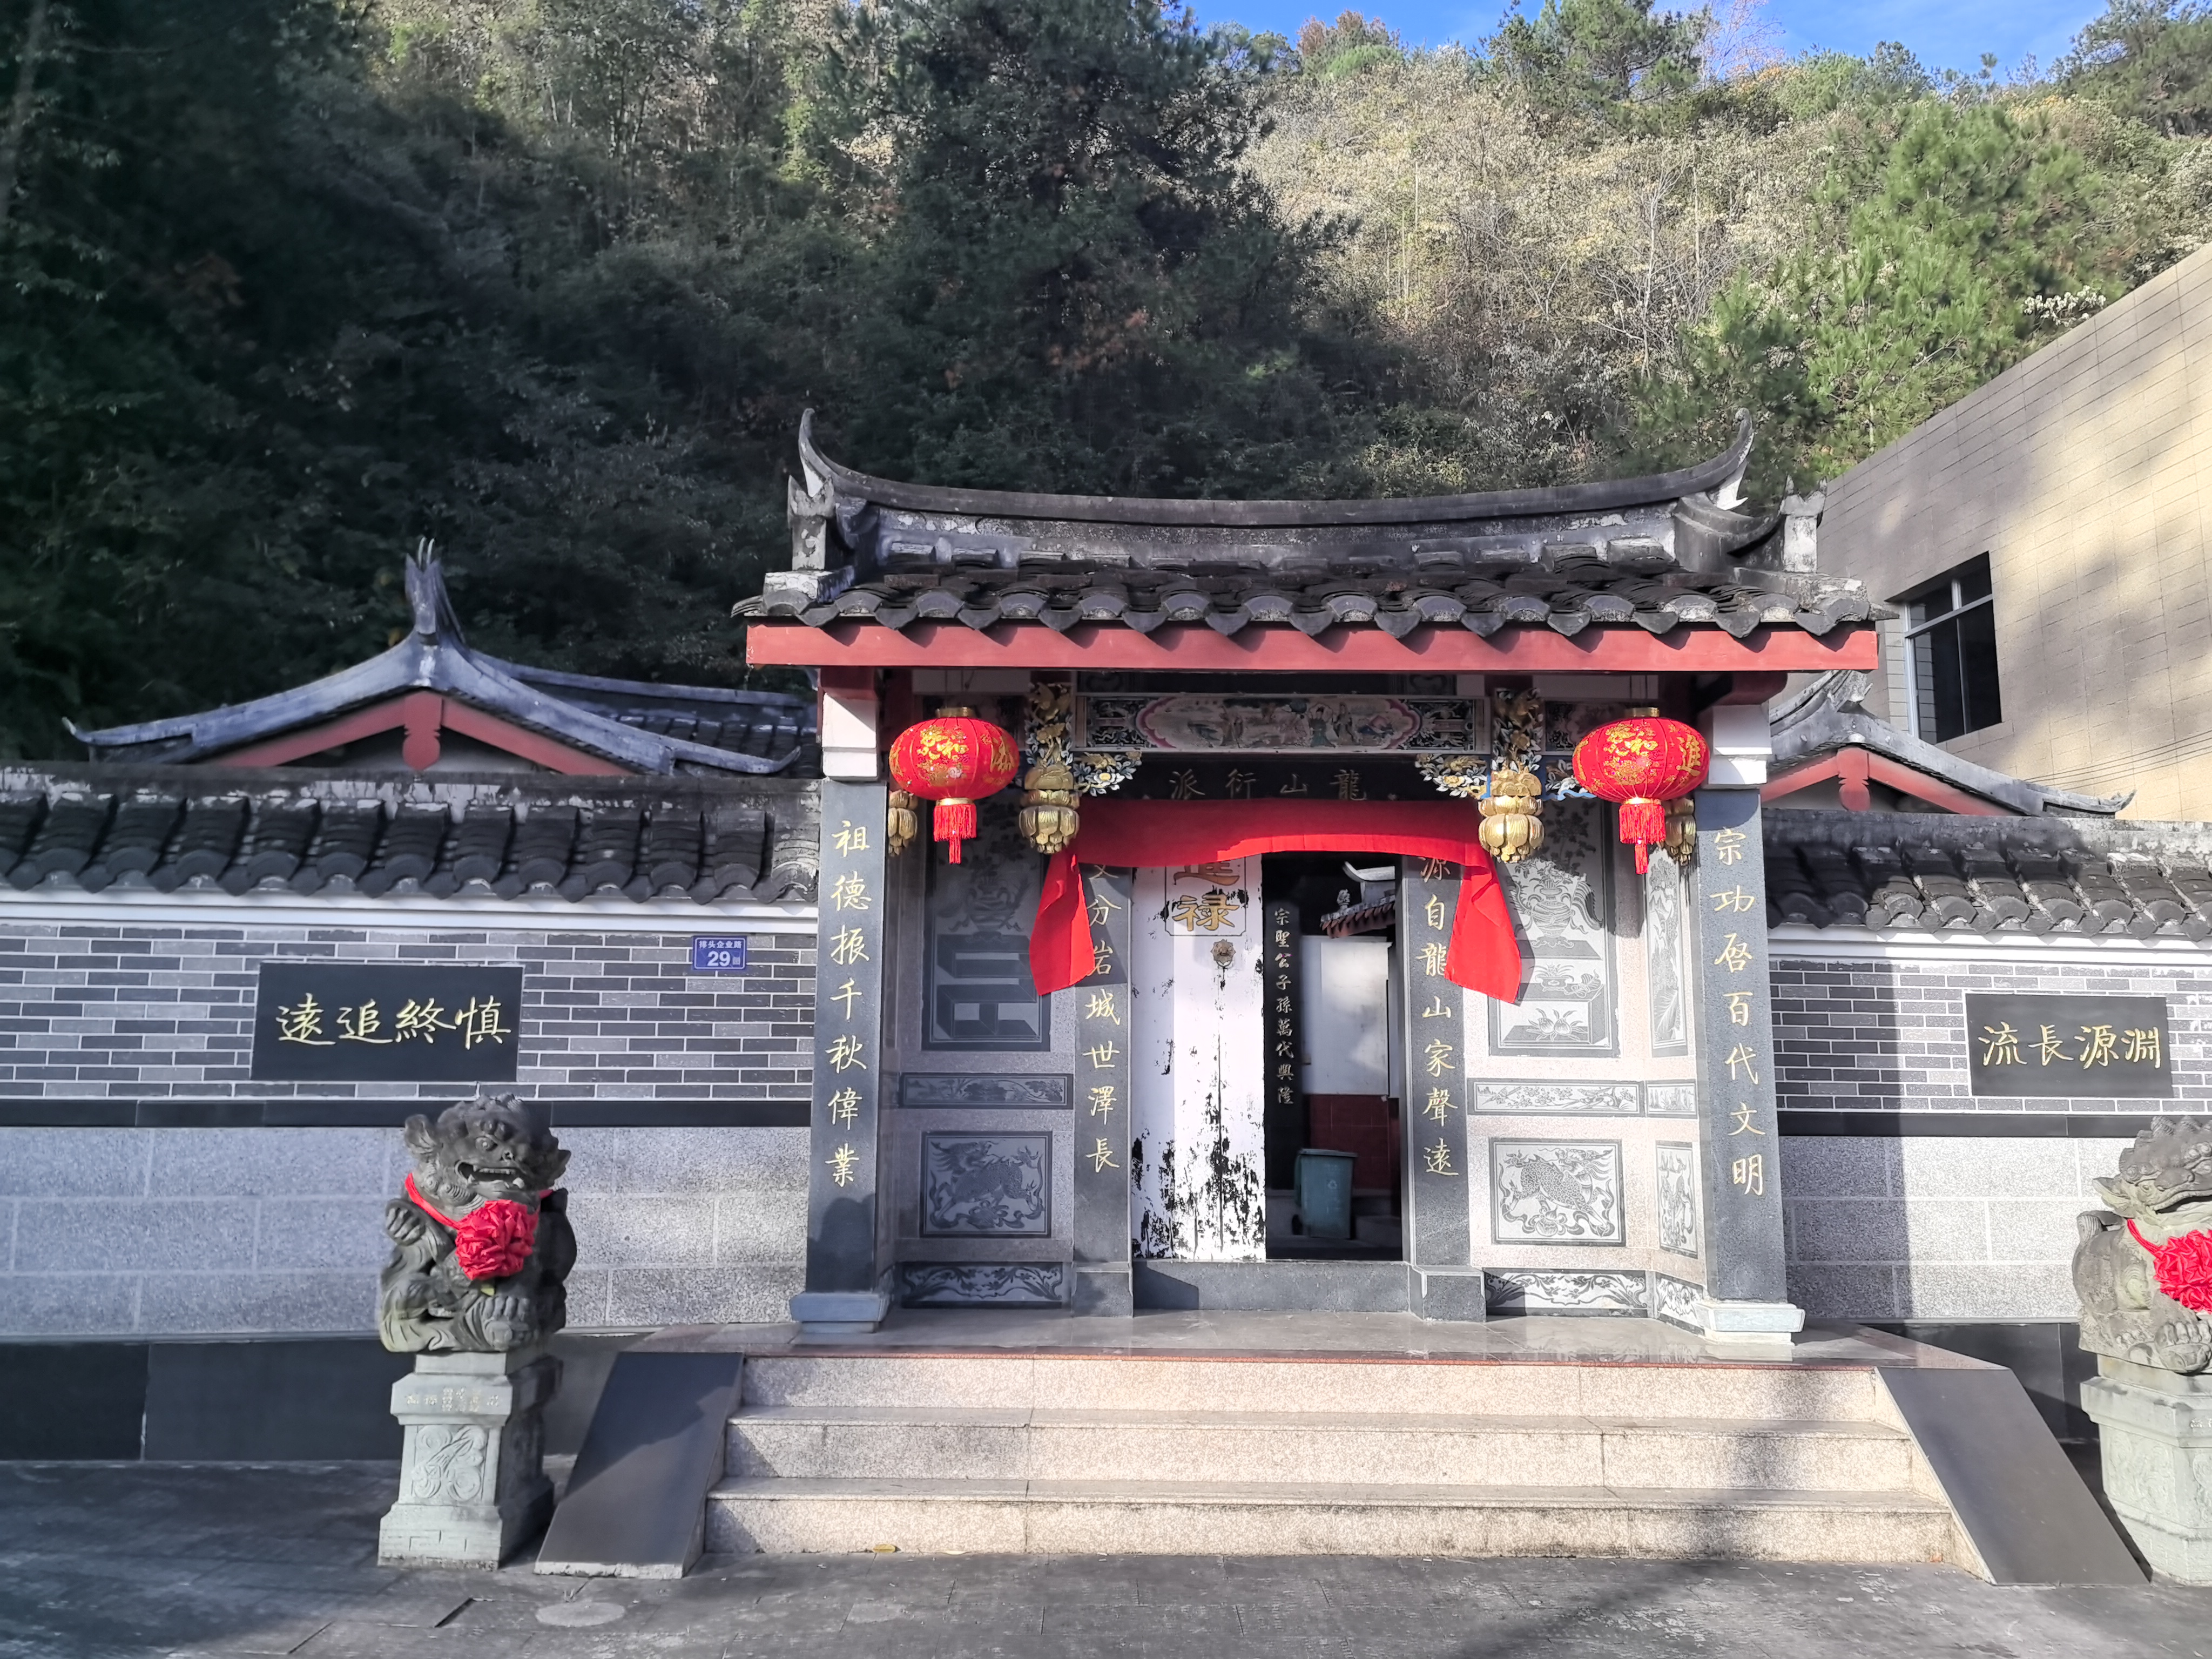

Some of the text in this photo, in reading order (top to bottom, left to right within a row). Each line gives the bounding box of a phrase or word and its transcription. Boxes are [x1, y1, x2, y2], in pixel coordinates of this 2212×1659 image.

[699, 940, 742, 949] 排头企业路
[707, 950, 731, 967] 29
